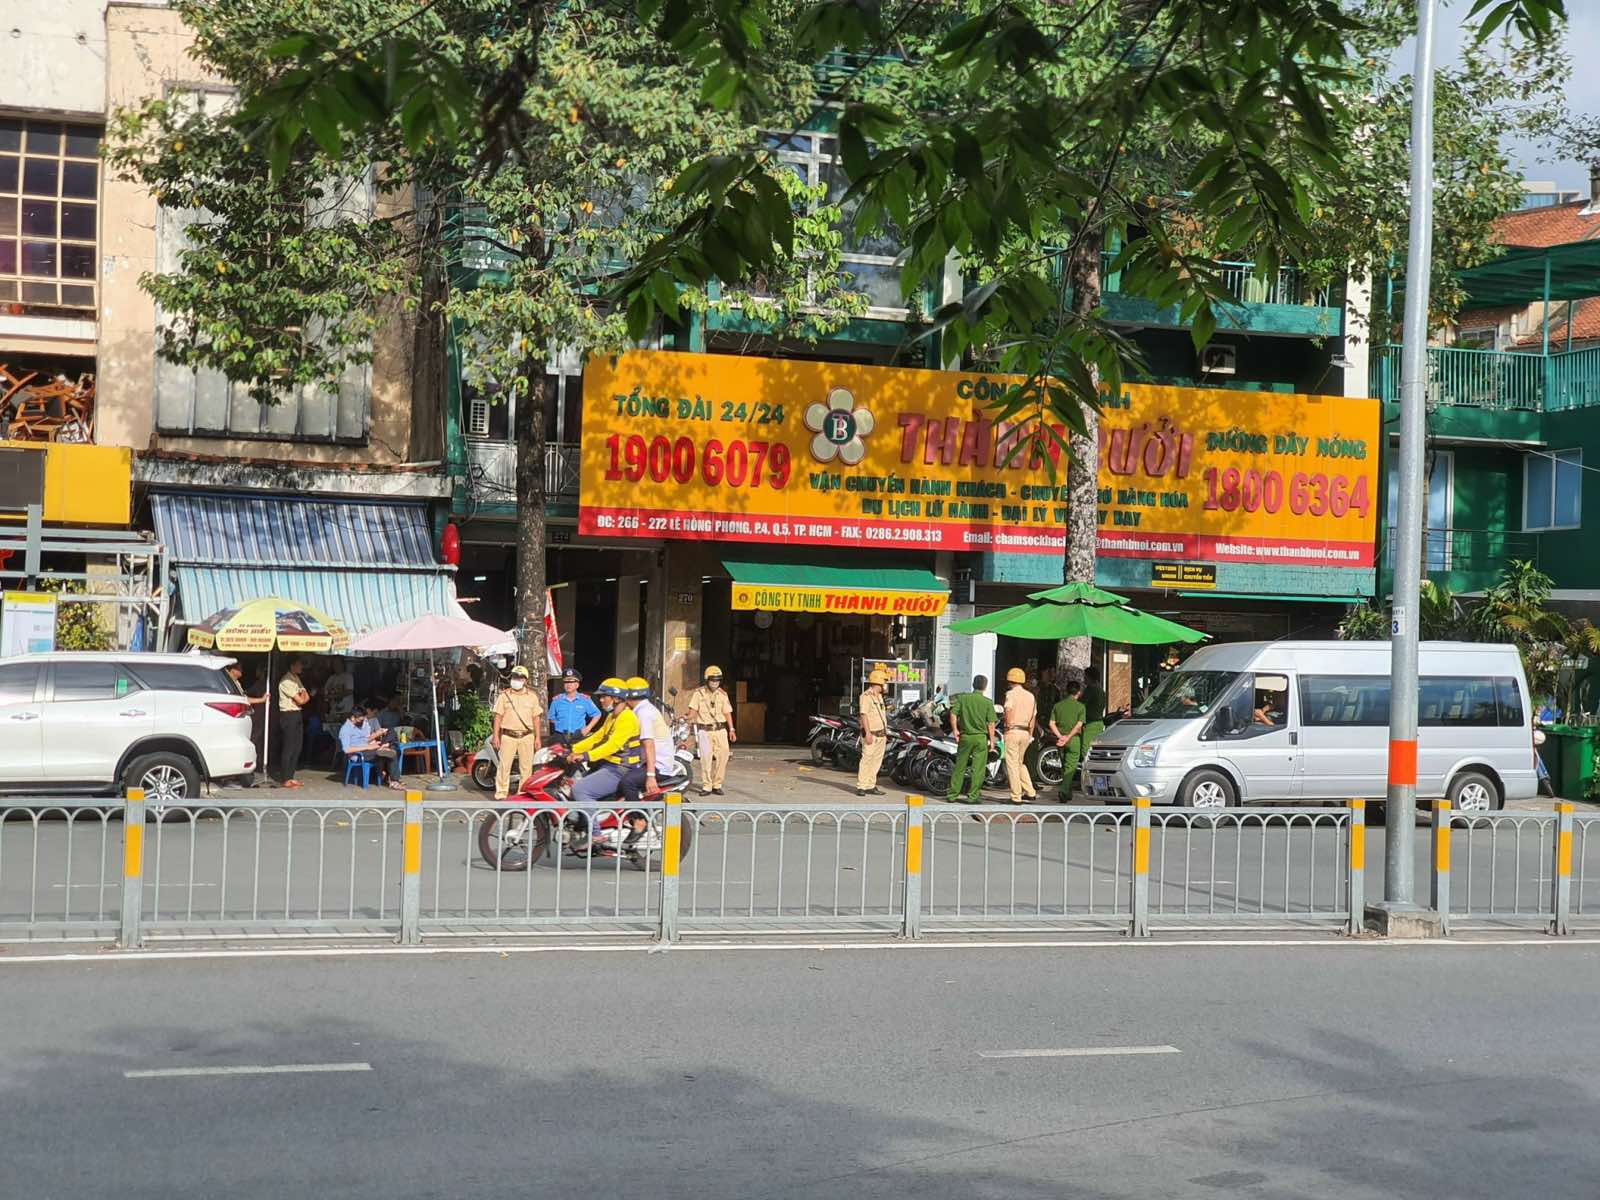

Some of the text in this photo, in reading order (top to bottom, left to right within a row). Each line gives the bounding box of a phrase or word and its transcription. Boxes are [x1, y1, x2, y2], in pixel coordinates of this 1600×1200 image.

[614, 384, 785, 425] TỔNG ĐÀI 24/24
[1098, 415, 1195, 479] ƯỞI
[1206, 426, 1367, 460] ĐƯỜNG DÂY NÓNG
[604, 433, 792, 490] 1900 6079
[809, 470, 841, 493] VẬN
[910, 476, 952, 496] HÀNH
[956, 479, 1006, 498] KHÁCH
[1117, 487, 1156, 506] HÀNG
[1160, 490, 1188, 508] HÓA
[1203, 466, 1370, 519] 1800 6364
[597, 515, 616, 528] ĐC:
[617, 515, 639, 529] 266
[648, 517, 667, 530] 272
[669, 516, 681, 531] LÊ
[683, 514, 712, 532] HỒNG
[808, 524, 832, 537] HCM
[841, 526, 862, 539] FAX:
[865, 527, 942, 542] 0286.2.908.313
[888, 499, 921, 519] LỊCH
[948, 501, 989, 519] HÀNH
[1002, 505, 1027, 525] ĐẠI
[1032, 503, 1047, 522] LÝ
[1113, 510, 1141, 526] BAY
[963, 531, 993, 544] Email:
[754, 589, 781, 607] CÔNG
[783, 591, 796, 608] TY
[797, 592, 822, 609] TNHH
[892, 593, 940, 612] BƯỞI
